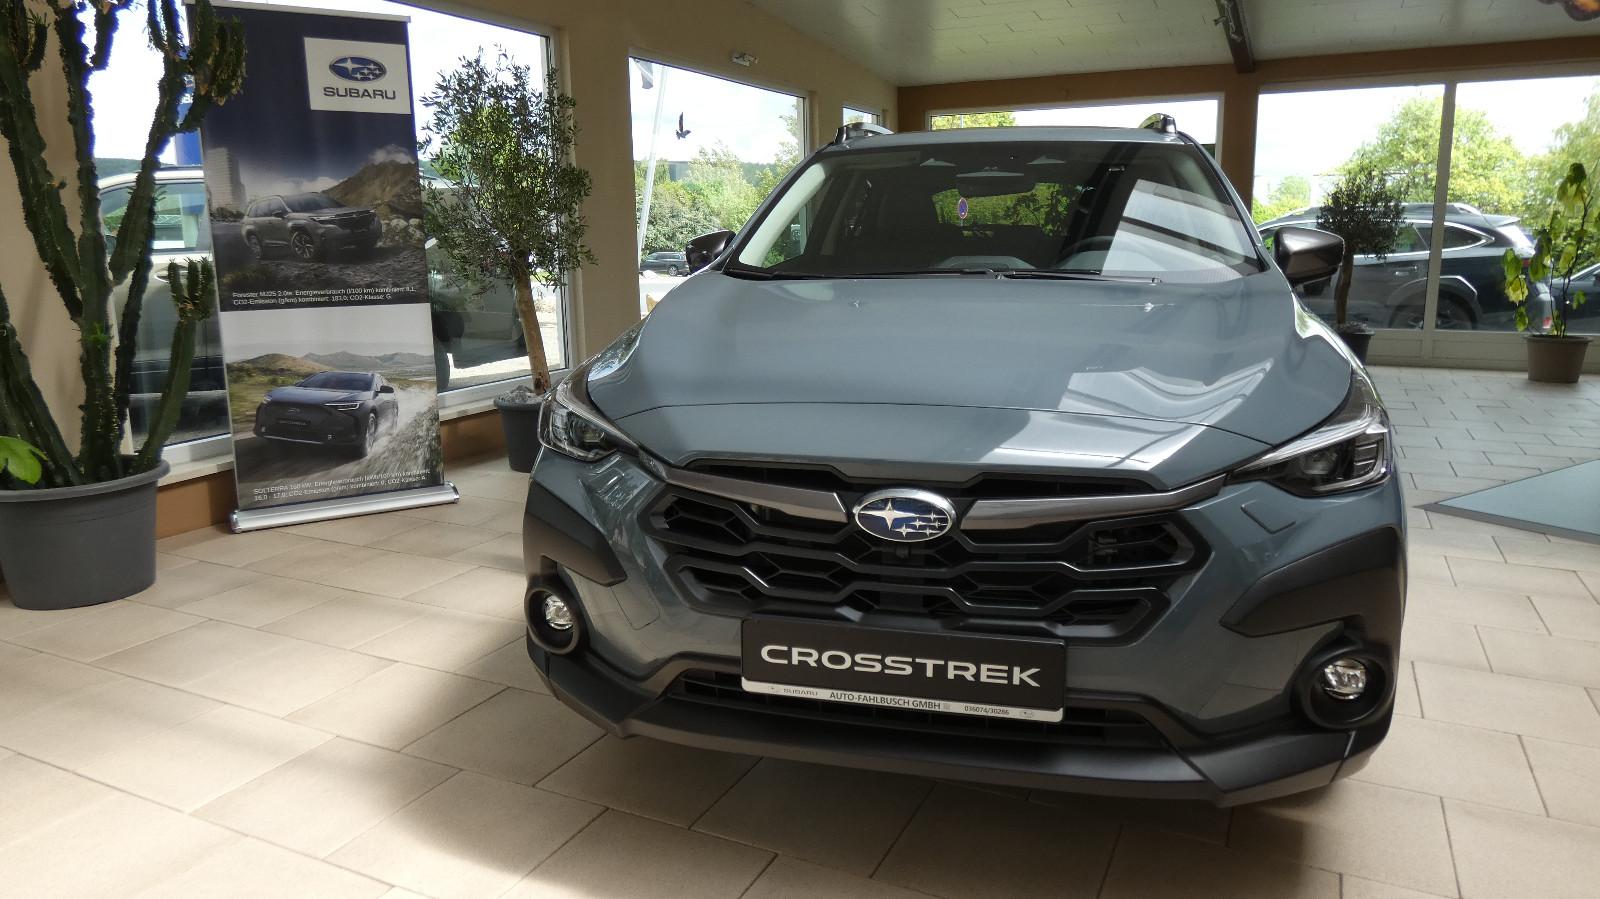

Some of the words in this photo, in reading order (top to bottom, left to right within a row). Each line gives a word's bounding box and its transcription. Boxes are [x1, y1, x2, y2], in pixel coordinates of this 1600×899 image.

[323, 86, 396, 100] SUBARU
[760, 644, 1041, 688] CROSSTREK
[829, 691, 910, 708] AUTO-FAHLBUSCH
[911, 699, 941, 710] GMBH
